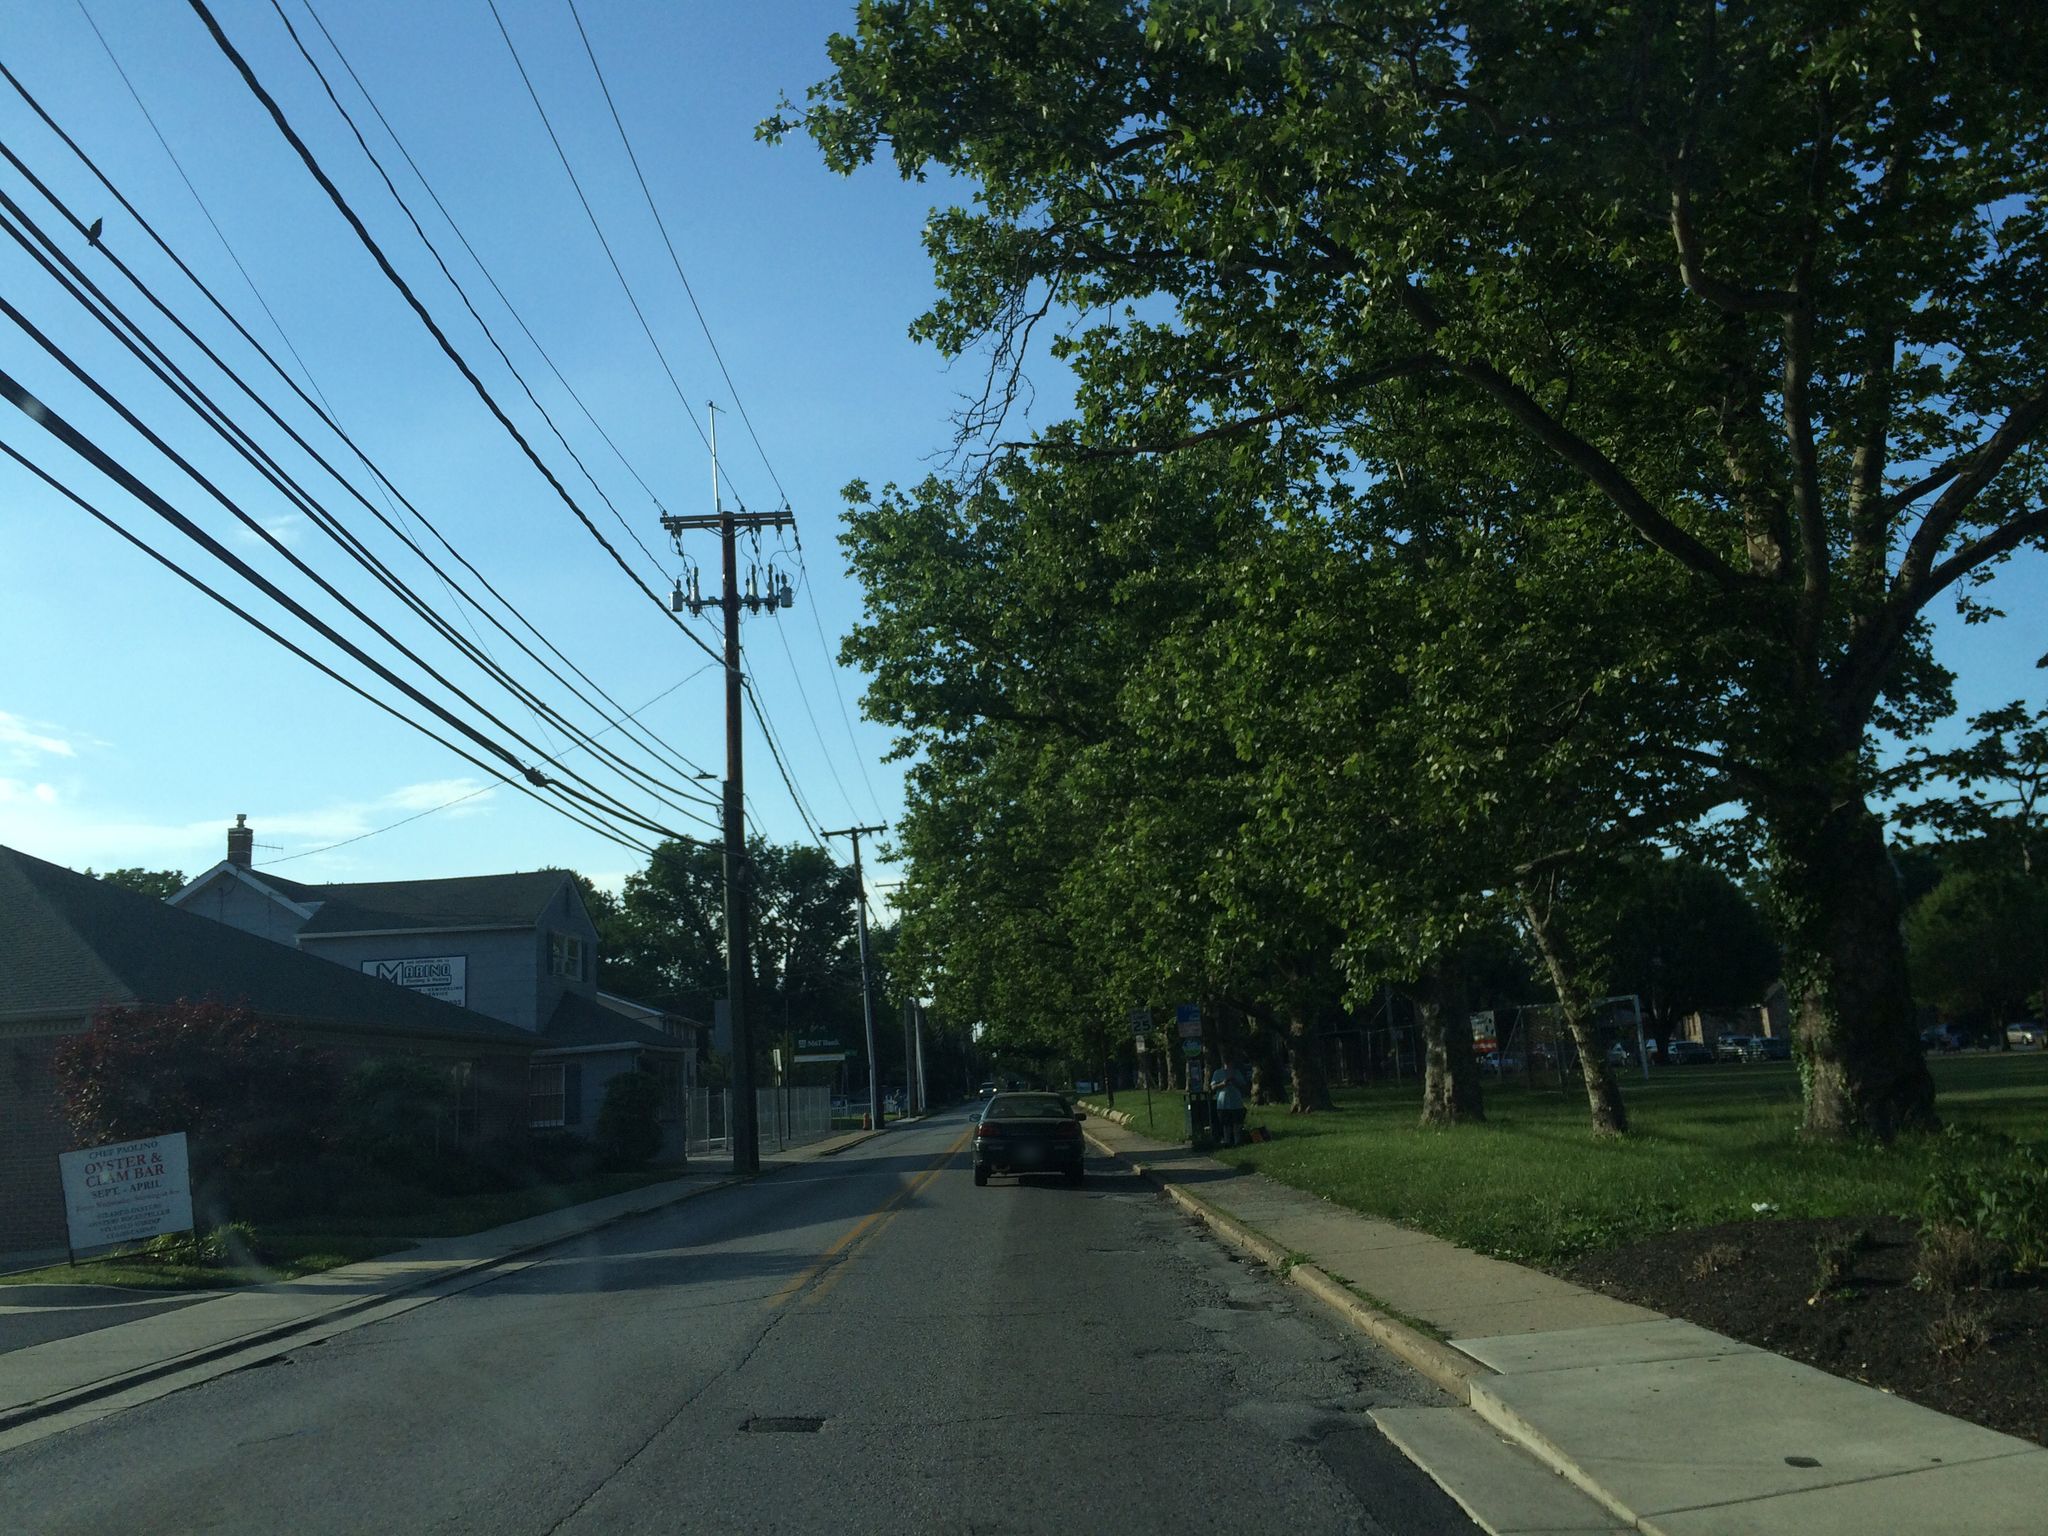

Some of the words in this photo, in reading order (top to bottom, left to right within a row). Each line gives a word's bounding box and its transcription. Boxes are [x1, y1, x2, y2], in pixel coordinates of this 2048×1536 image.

[1133, 1020, 1151, 1032] 25
[85, 1154, 146, 1175] OYSTER
[151, 1152, 162, 1163] &
[86, 1170, 129, 1188] CLAM
[134, 1164, 165, 1179] BAR
[129, 1180, 161, 1192] APRIL
